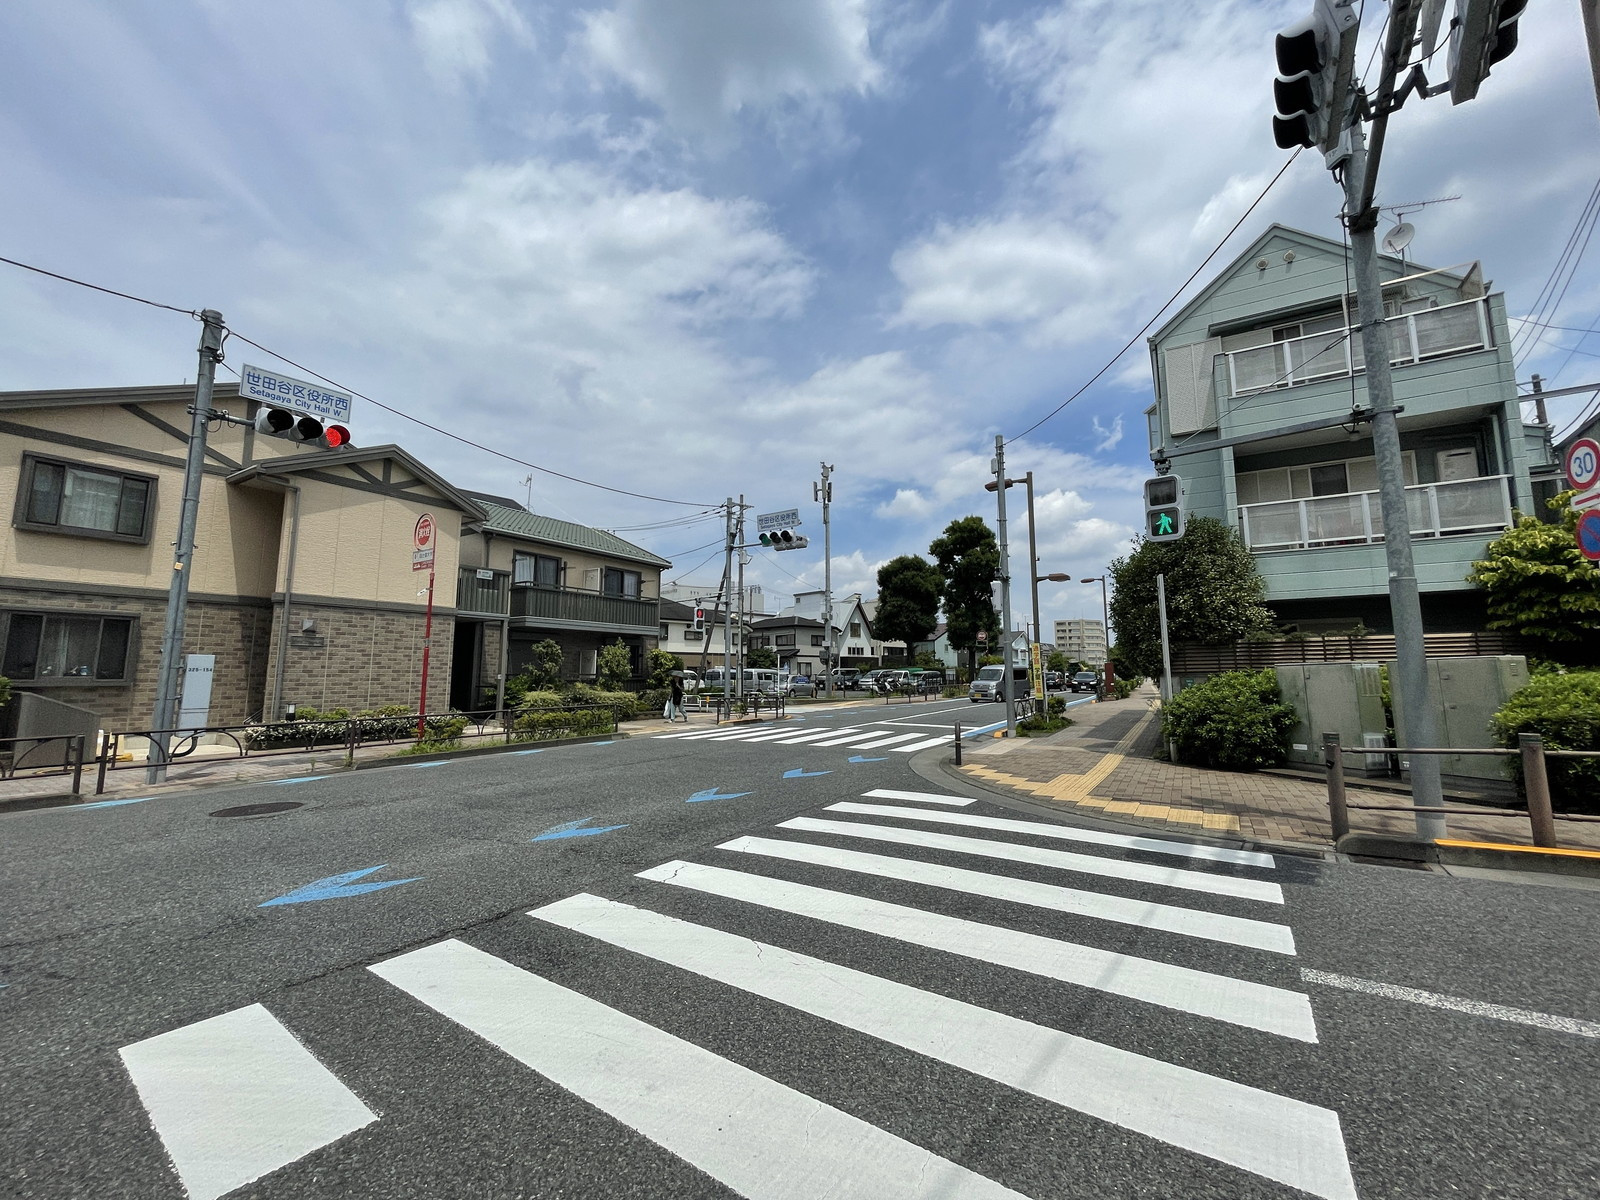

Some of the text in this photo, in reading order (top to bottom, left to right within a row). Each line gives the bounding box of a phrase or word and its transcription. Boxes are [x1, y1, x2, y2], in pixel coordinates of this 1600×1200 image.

[246, 371, 349, 411] 世田谷区役所西
[249, 386, 343, 418] Setagaya City Hall W.
[1573, 452, 1594, 477] 30
